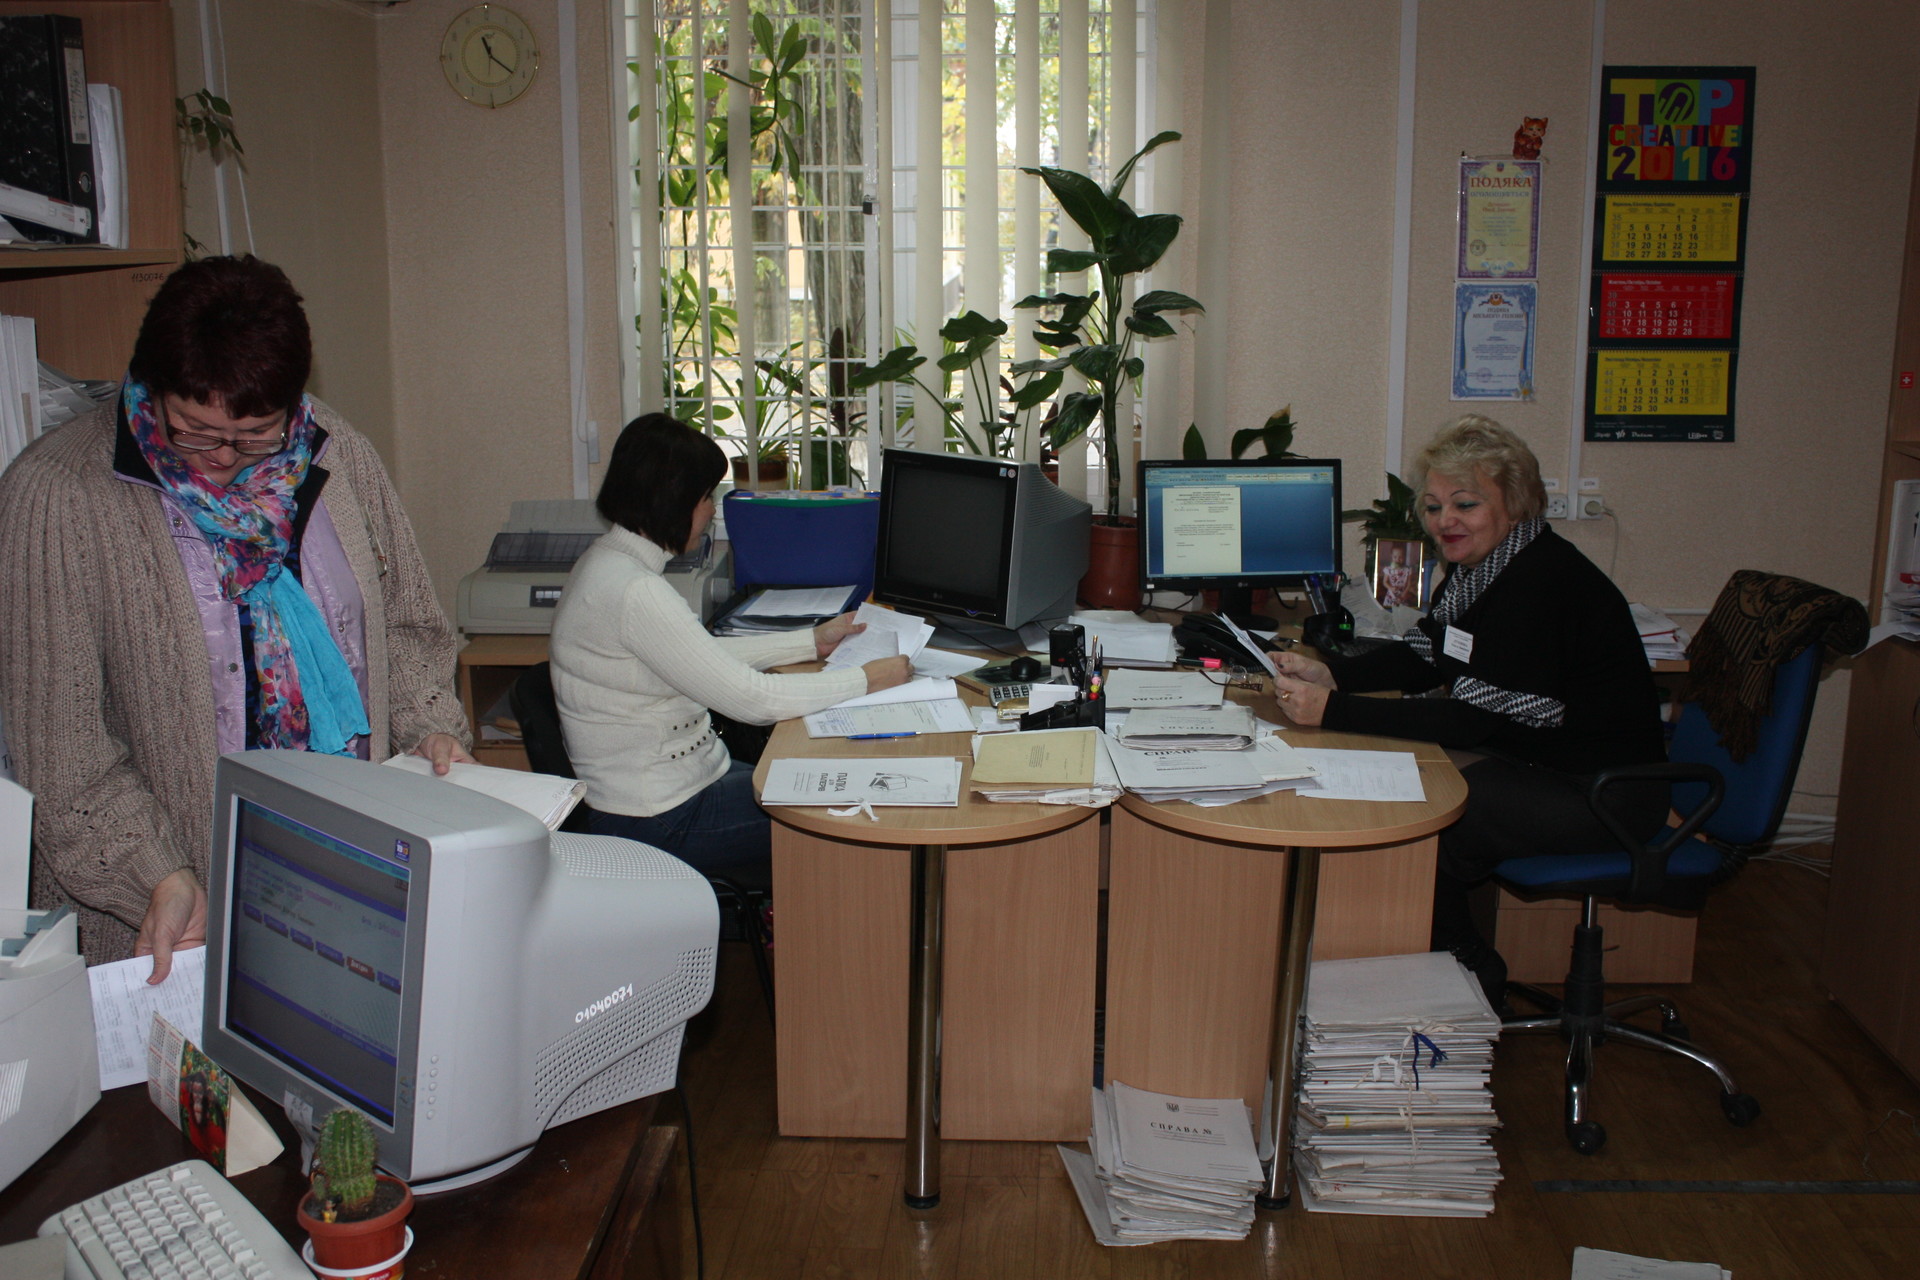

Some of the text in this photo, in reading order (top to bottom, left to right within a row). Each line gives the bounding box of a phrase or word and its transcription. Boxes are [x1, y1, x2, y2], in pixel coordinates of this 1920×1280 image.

[1608, 124, 1740, 147] CREATIVE
[1611, 146, 1738, 181] 2016
[1471, 176, 1532, 189] ПОДЯКА
[1677, 214, 1681, 222] 1
[1692, 214, 1697, 222] 2
[1625, 301, 1630, 309] 3
[1640, 301, 1645, 309] 4
[1656, 301, 1661, 309] 5
[1671, 301, 1676, 309] 6
[1687, 301, 1692, 309] 7
[1622, 319, 1631, 327] 17
[1638, 319, 1647, 327] 18
[1653, 319, 1662, 327] 19
[1668, 319, 1678, 327] 20
[1683, 319, 1692, 327] 21
[1622, 378, 1626, 386] 7
[1666, 378, 1674, 386] 10
[1681, 378, 1688, 386] 11
[1618, 396, 1627, 404] 21
[1633, 396, 1643, 404] 22
[1648, 396, 1658, 404] 23
[1664, 396, 1673, 404] 24
[1680, 396, 1688, 404] 25
[835, 773, 847, 791] ПАПКА
[574, 983, 633, 1024] 01040071
[1150, 1121, 1199, 1134] СПРАВА
